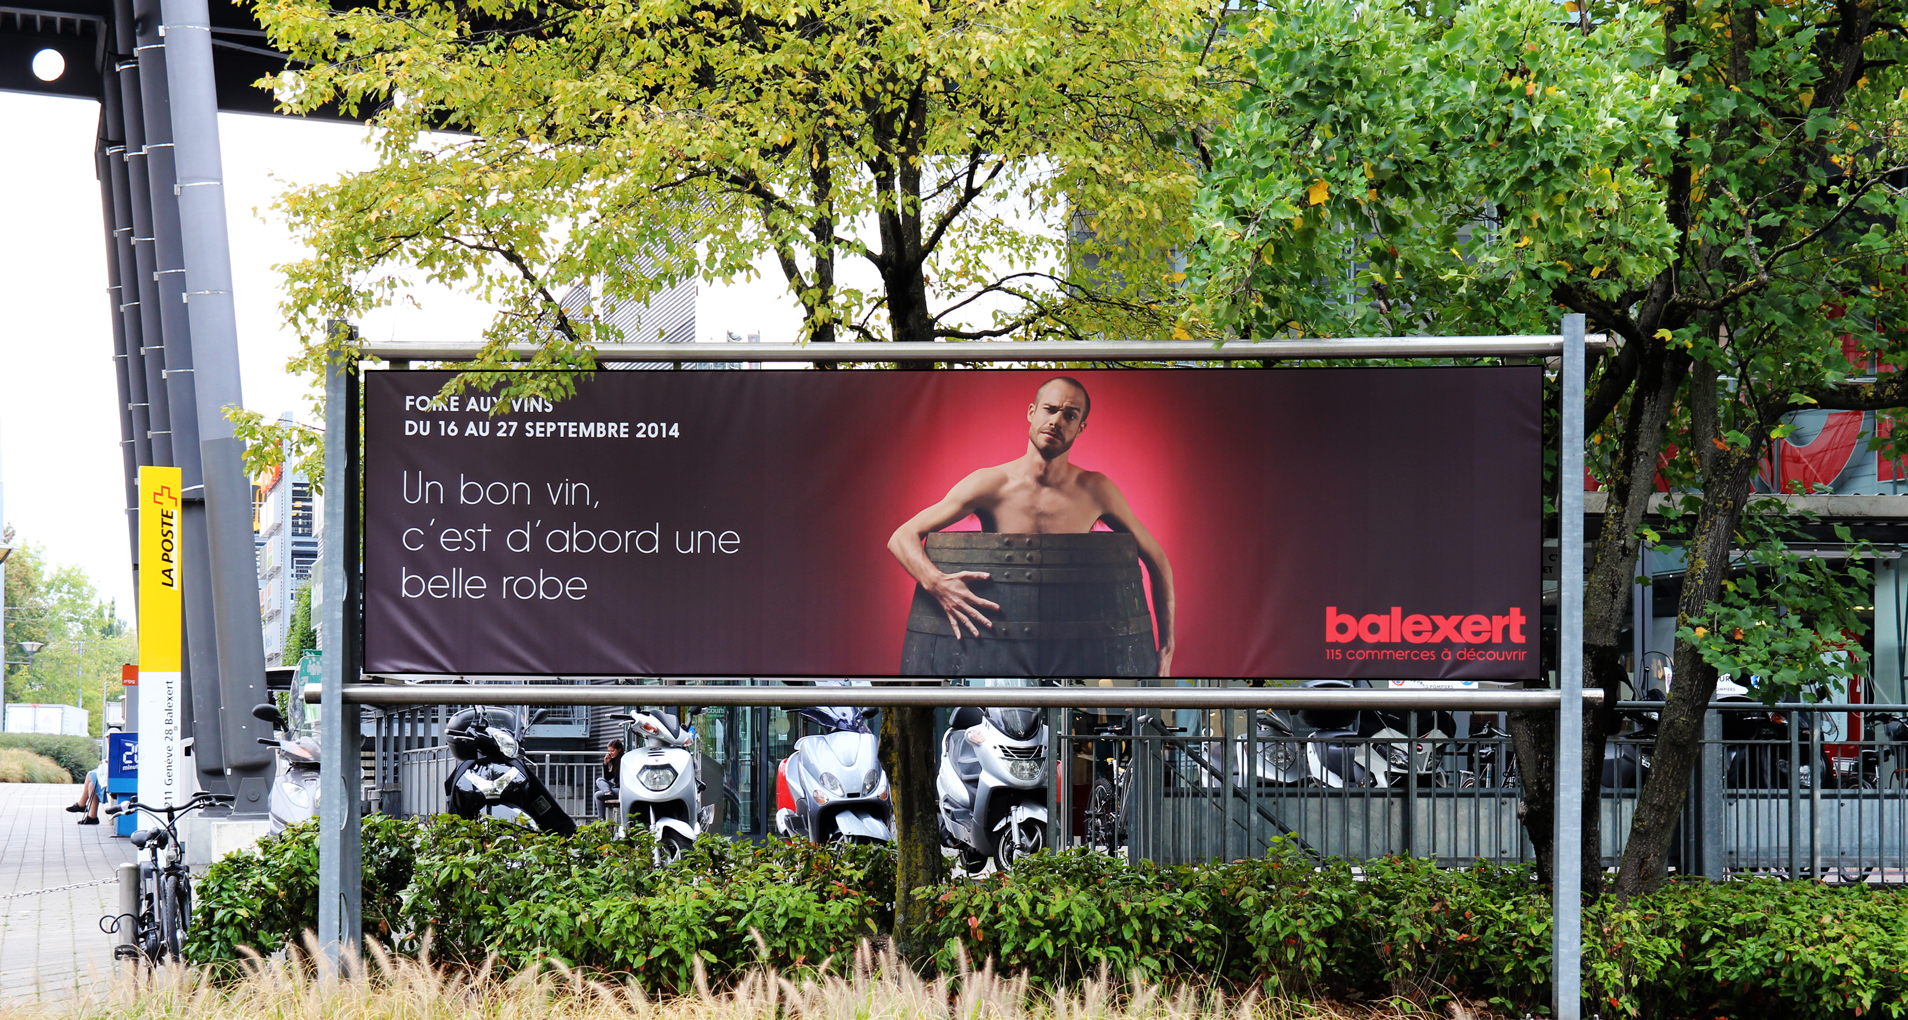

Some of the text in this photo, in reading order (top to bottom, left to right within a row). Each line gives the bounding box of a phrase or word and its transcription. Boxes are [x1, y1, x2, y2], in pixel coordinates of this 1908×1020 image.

[510, 396, 554, 413] VINS
[404, 420, 680, 439] DU 16 AU 27 SEPTEMBRE 2014
[403, 470, 599, 509] Un bon vin,
[161, 508, 174, 587] LA POSTE
[402, 518, 741, 554] c'est d'abord une
[401, 566, 588, 600] belle robe
[1325, 606, 1526, 644] balexert
[1325, 647, 1527, 661] 115 commerces à découvrir
[164, 680, 173, 725] Balexert
[165, 728, 173, 742] 28
